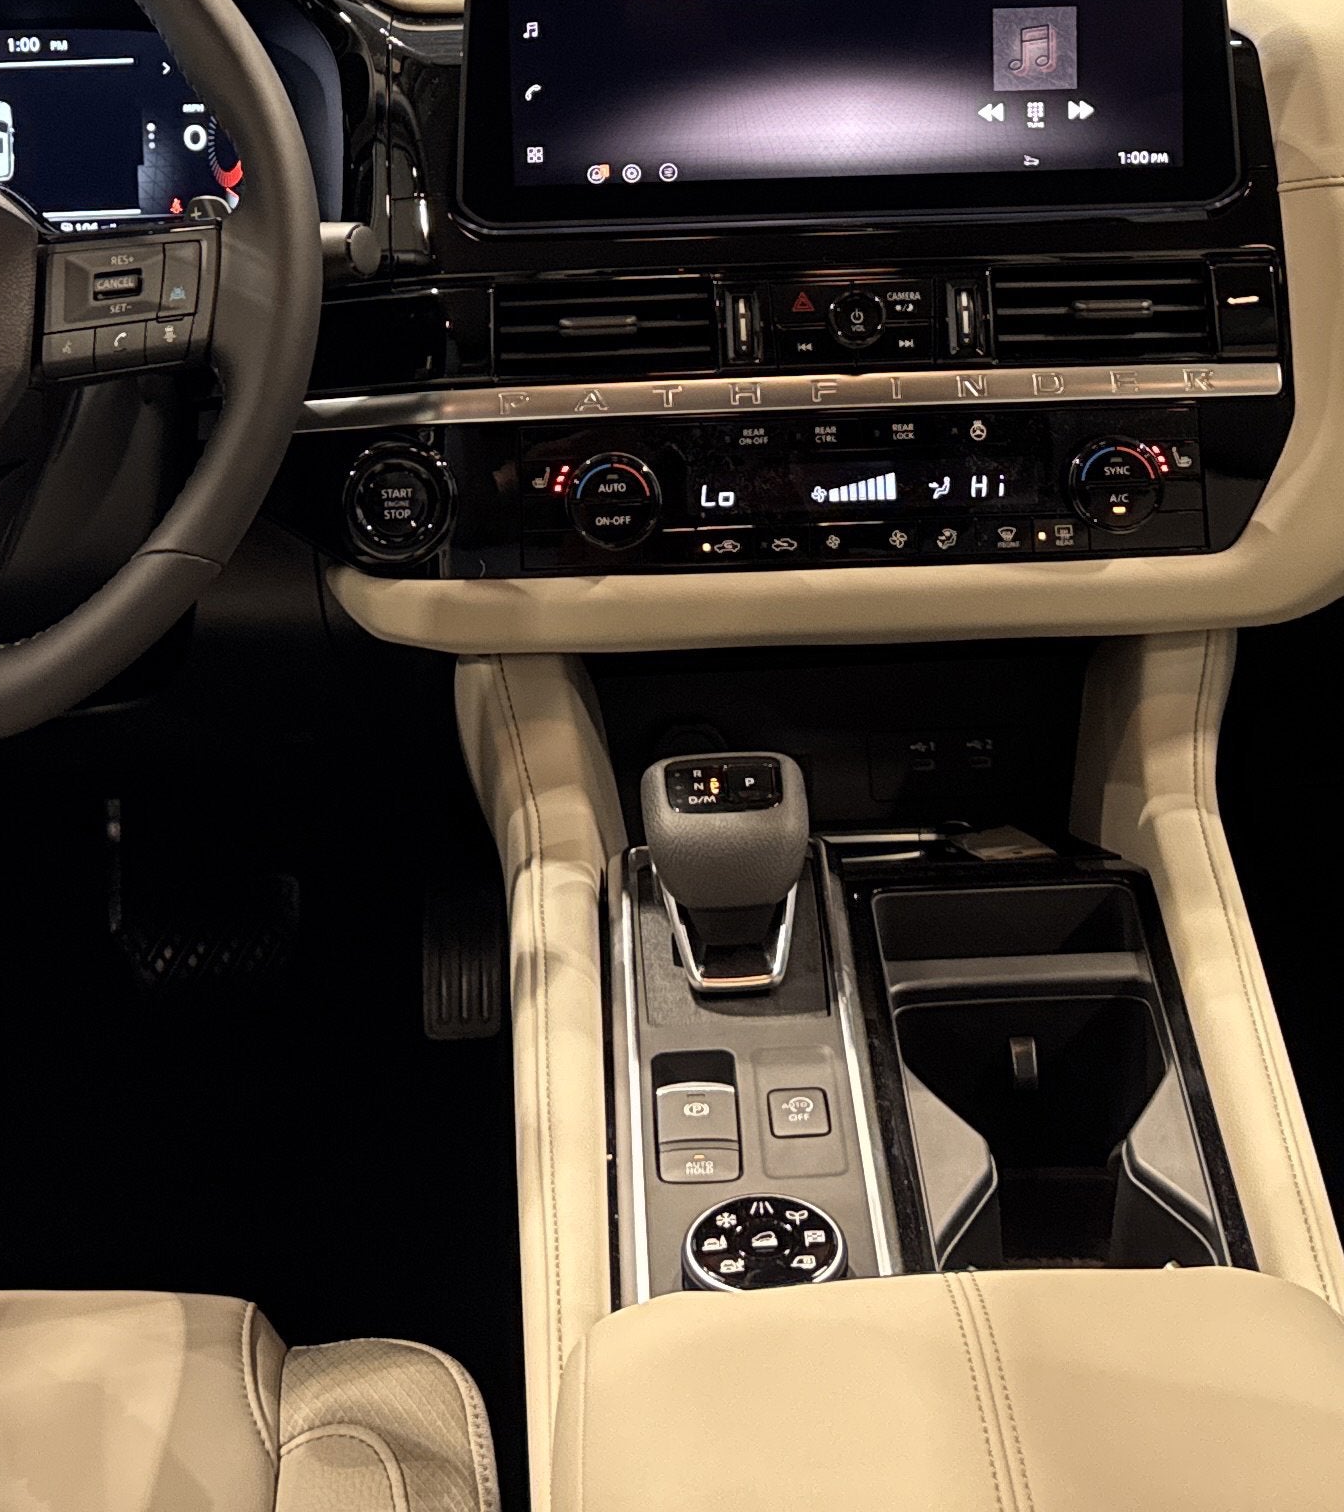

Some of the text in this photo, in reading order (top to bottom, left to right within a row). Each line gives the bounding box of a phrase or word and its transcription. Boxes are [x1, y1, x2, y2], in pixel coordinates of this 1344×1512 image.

[7, 36, 69, 53] 1:00 PM
[183, 124, 207, 152] 0
[1117, 150, 1169, 166] 1:00 PM
[96, 277, 135, 289] CANCEL
[886, 291, 921, 301] CAMERA
[851, 324, 866, 332] VOL
[742, 428, 765, 437] REAR
[814, 426, 837, 435] REAR
[892, 423, 914, 432] REAR
[815, 434, 838, 443] CTRL
[892, 431, 915, 440] LOCK
[1103, 465, 1131, 476] SYNC
[598, 482, 627, 493] AUTO
[381, 488, 413, 499] START
[1109, 493, 1130, 503] A/C
[384, 509, 412, 520] STOP
[595, 515, 632, 526] ON-OFF
[692, 769, 702, 778] R
[693, 782, 704, 791] N
[744, 777, 755, 787] P
[688, 795, 717, 805] D/M
[788, 1113, 811, 1122] OFF
[685, 1160, 714, 1168] AUTO
[685, 1167, 714, 1176] HOLD
